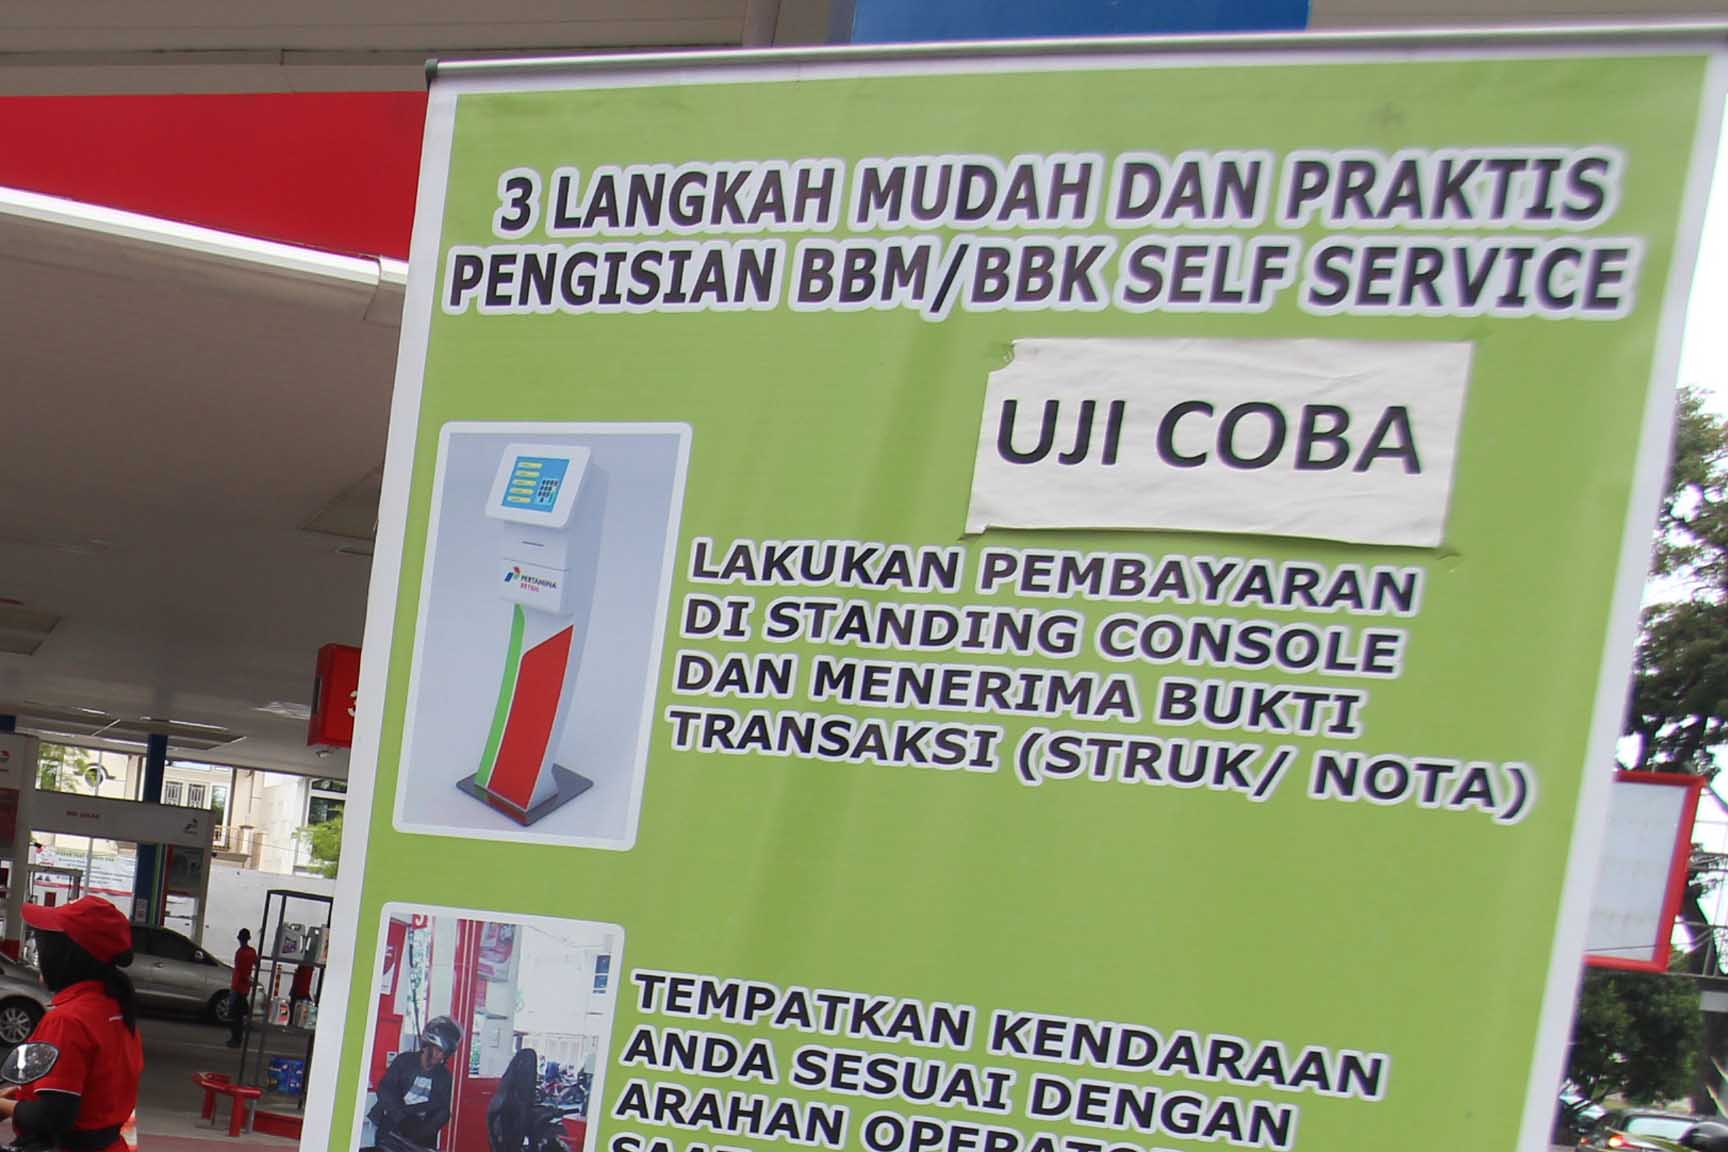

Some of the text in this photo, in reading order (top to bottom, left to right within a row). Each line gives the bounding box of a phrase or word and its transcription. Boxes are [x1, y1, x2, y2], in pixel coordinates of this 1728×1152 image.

[498, 155, 1611, 233] 3 LANGKAH MUDAH DAN PRAKTIS
[448, 241, 1630, 315] PENGISIAN BBM/BBK SELF SERVICE
[996, 397, 1423, 476] UJI COBA
[691, 540, 1418, 614] LAKUKAN PEMBAYARAN
[683, 596, 1401, 675] DI STANDING CONSOLE
[675, 652, 1362, 736] DAN MENERIMA BUKTI
[667, 708, 1529, 821] TRANSAKSI (STRUK/ NOTA)
[633, 971, 1384, 1098] TEMPATKAN KENDARAAN
[614, 1081, 846, 1147] ARAHAN
[621, 1027, 1294, 1149] ANDA SESUAI DENGAN
